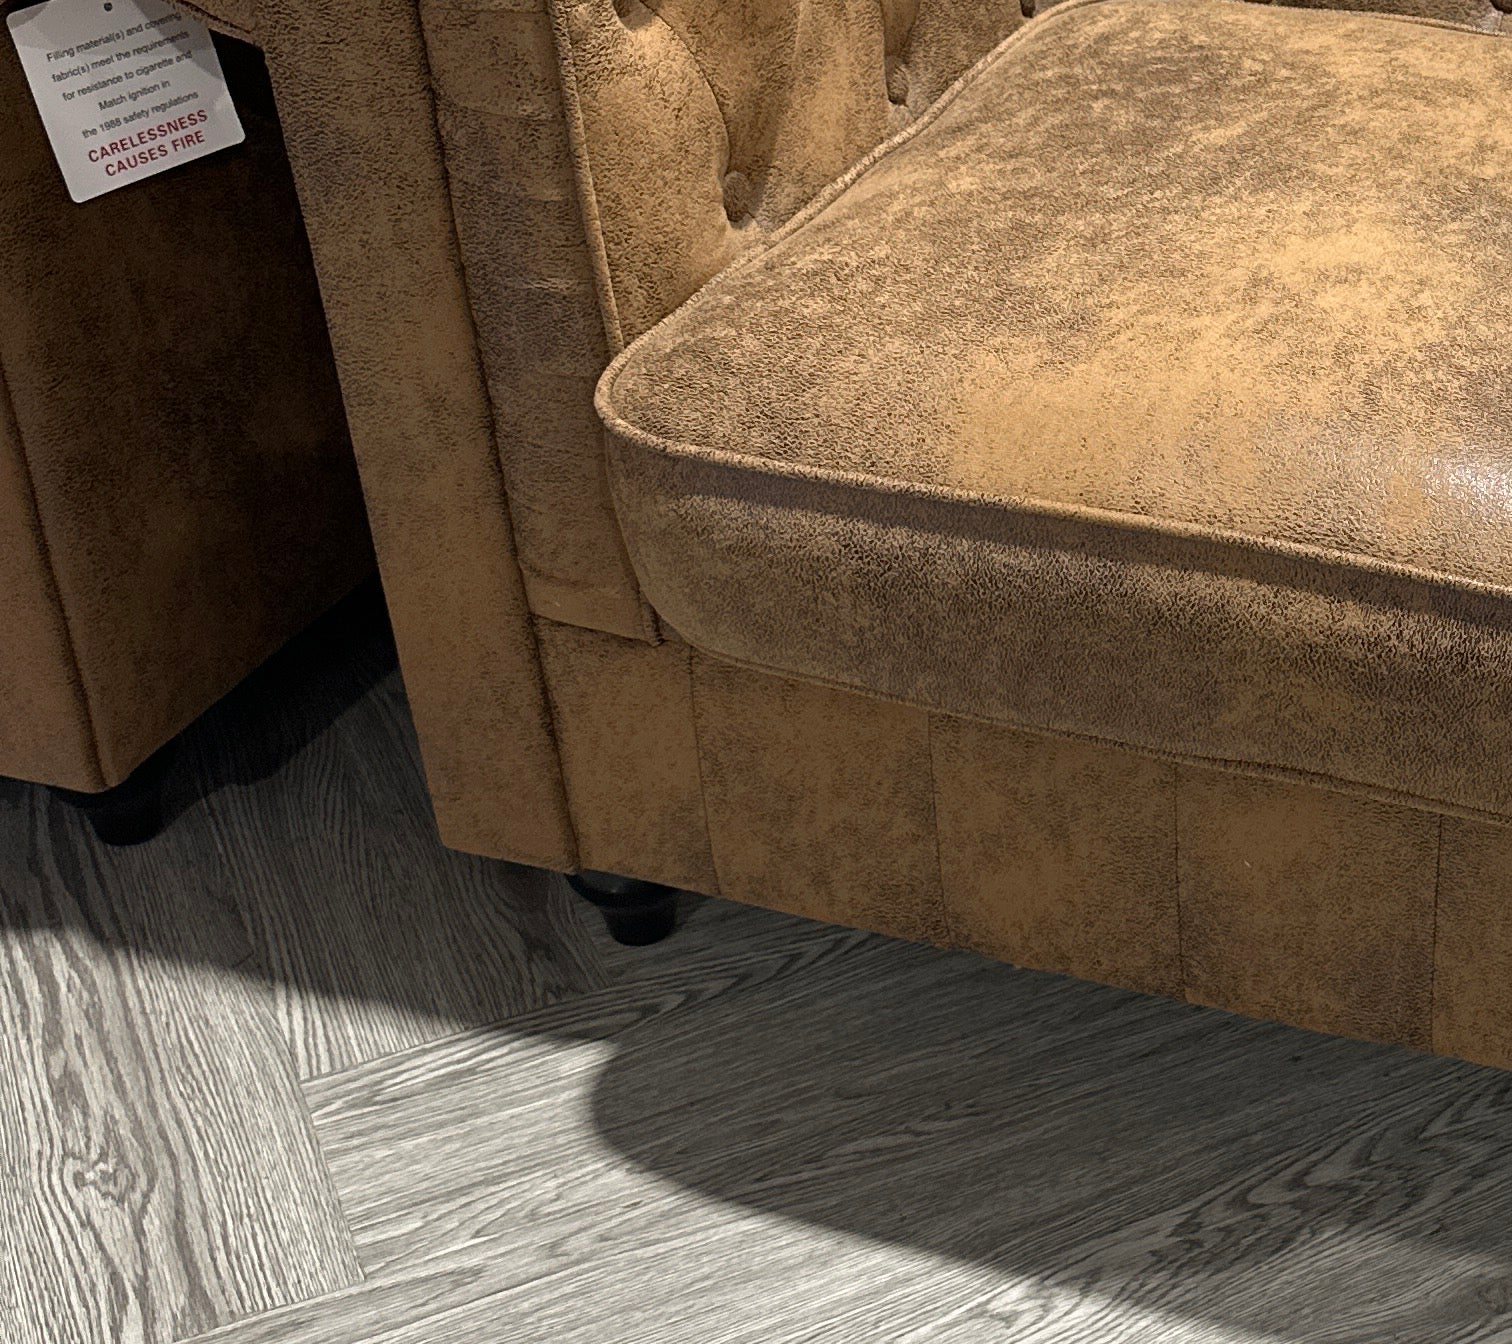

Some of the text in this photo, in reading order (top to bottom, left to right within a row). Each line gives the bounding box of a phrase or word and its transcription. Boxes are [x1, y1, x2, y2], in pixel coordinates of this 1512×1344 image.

[46, 12, 182, 62] Filling material(s) and covering
[52, 30, 190, 83] fabric(s) meet the requirements
[62, 49, 193, 102] for resistance to cigarette and
[98, 80, 171, 111] Match ignition in
[82, 91, 199, 139] the 1988 safety regulations
[88, 109, 208, 163] CARELESSNESS
[105, 130, 206, 177] CAUSES FIRE
